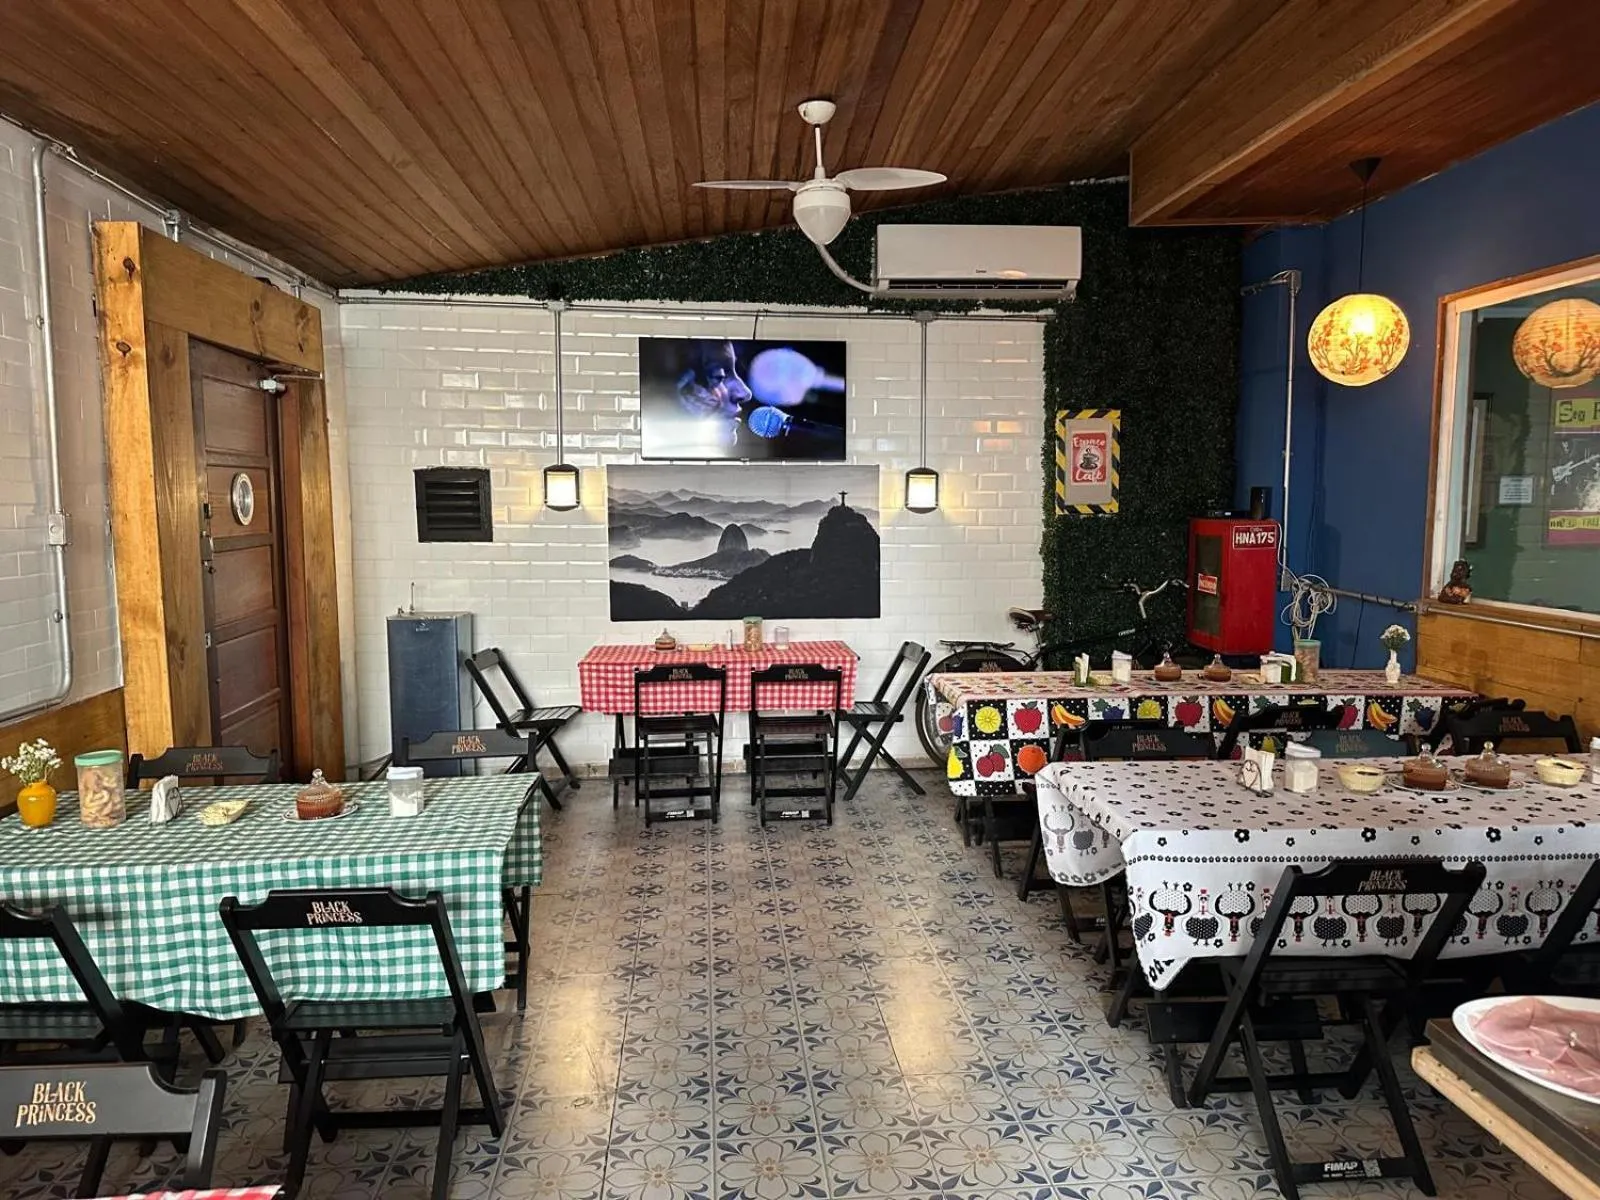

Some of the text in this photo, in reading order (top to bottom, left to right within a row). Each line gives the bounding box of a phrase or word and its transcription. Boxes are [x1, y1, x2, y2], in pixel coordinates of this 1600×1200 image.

[1235, 531, 1275, 545] HNA175
[311, 900, 351, 914] BLACK
[32, 1080, 88, 1104] BLACK
[1324, 1161, 1359, 1172] FIMAP
